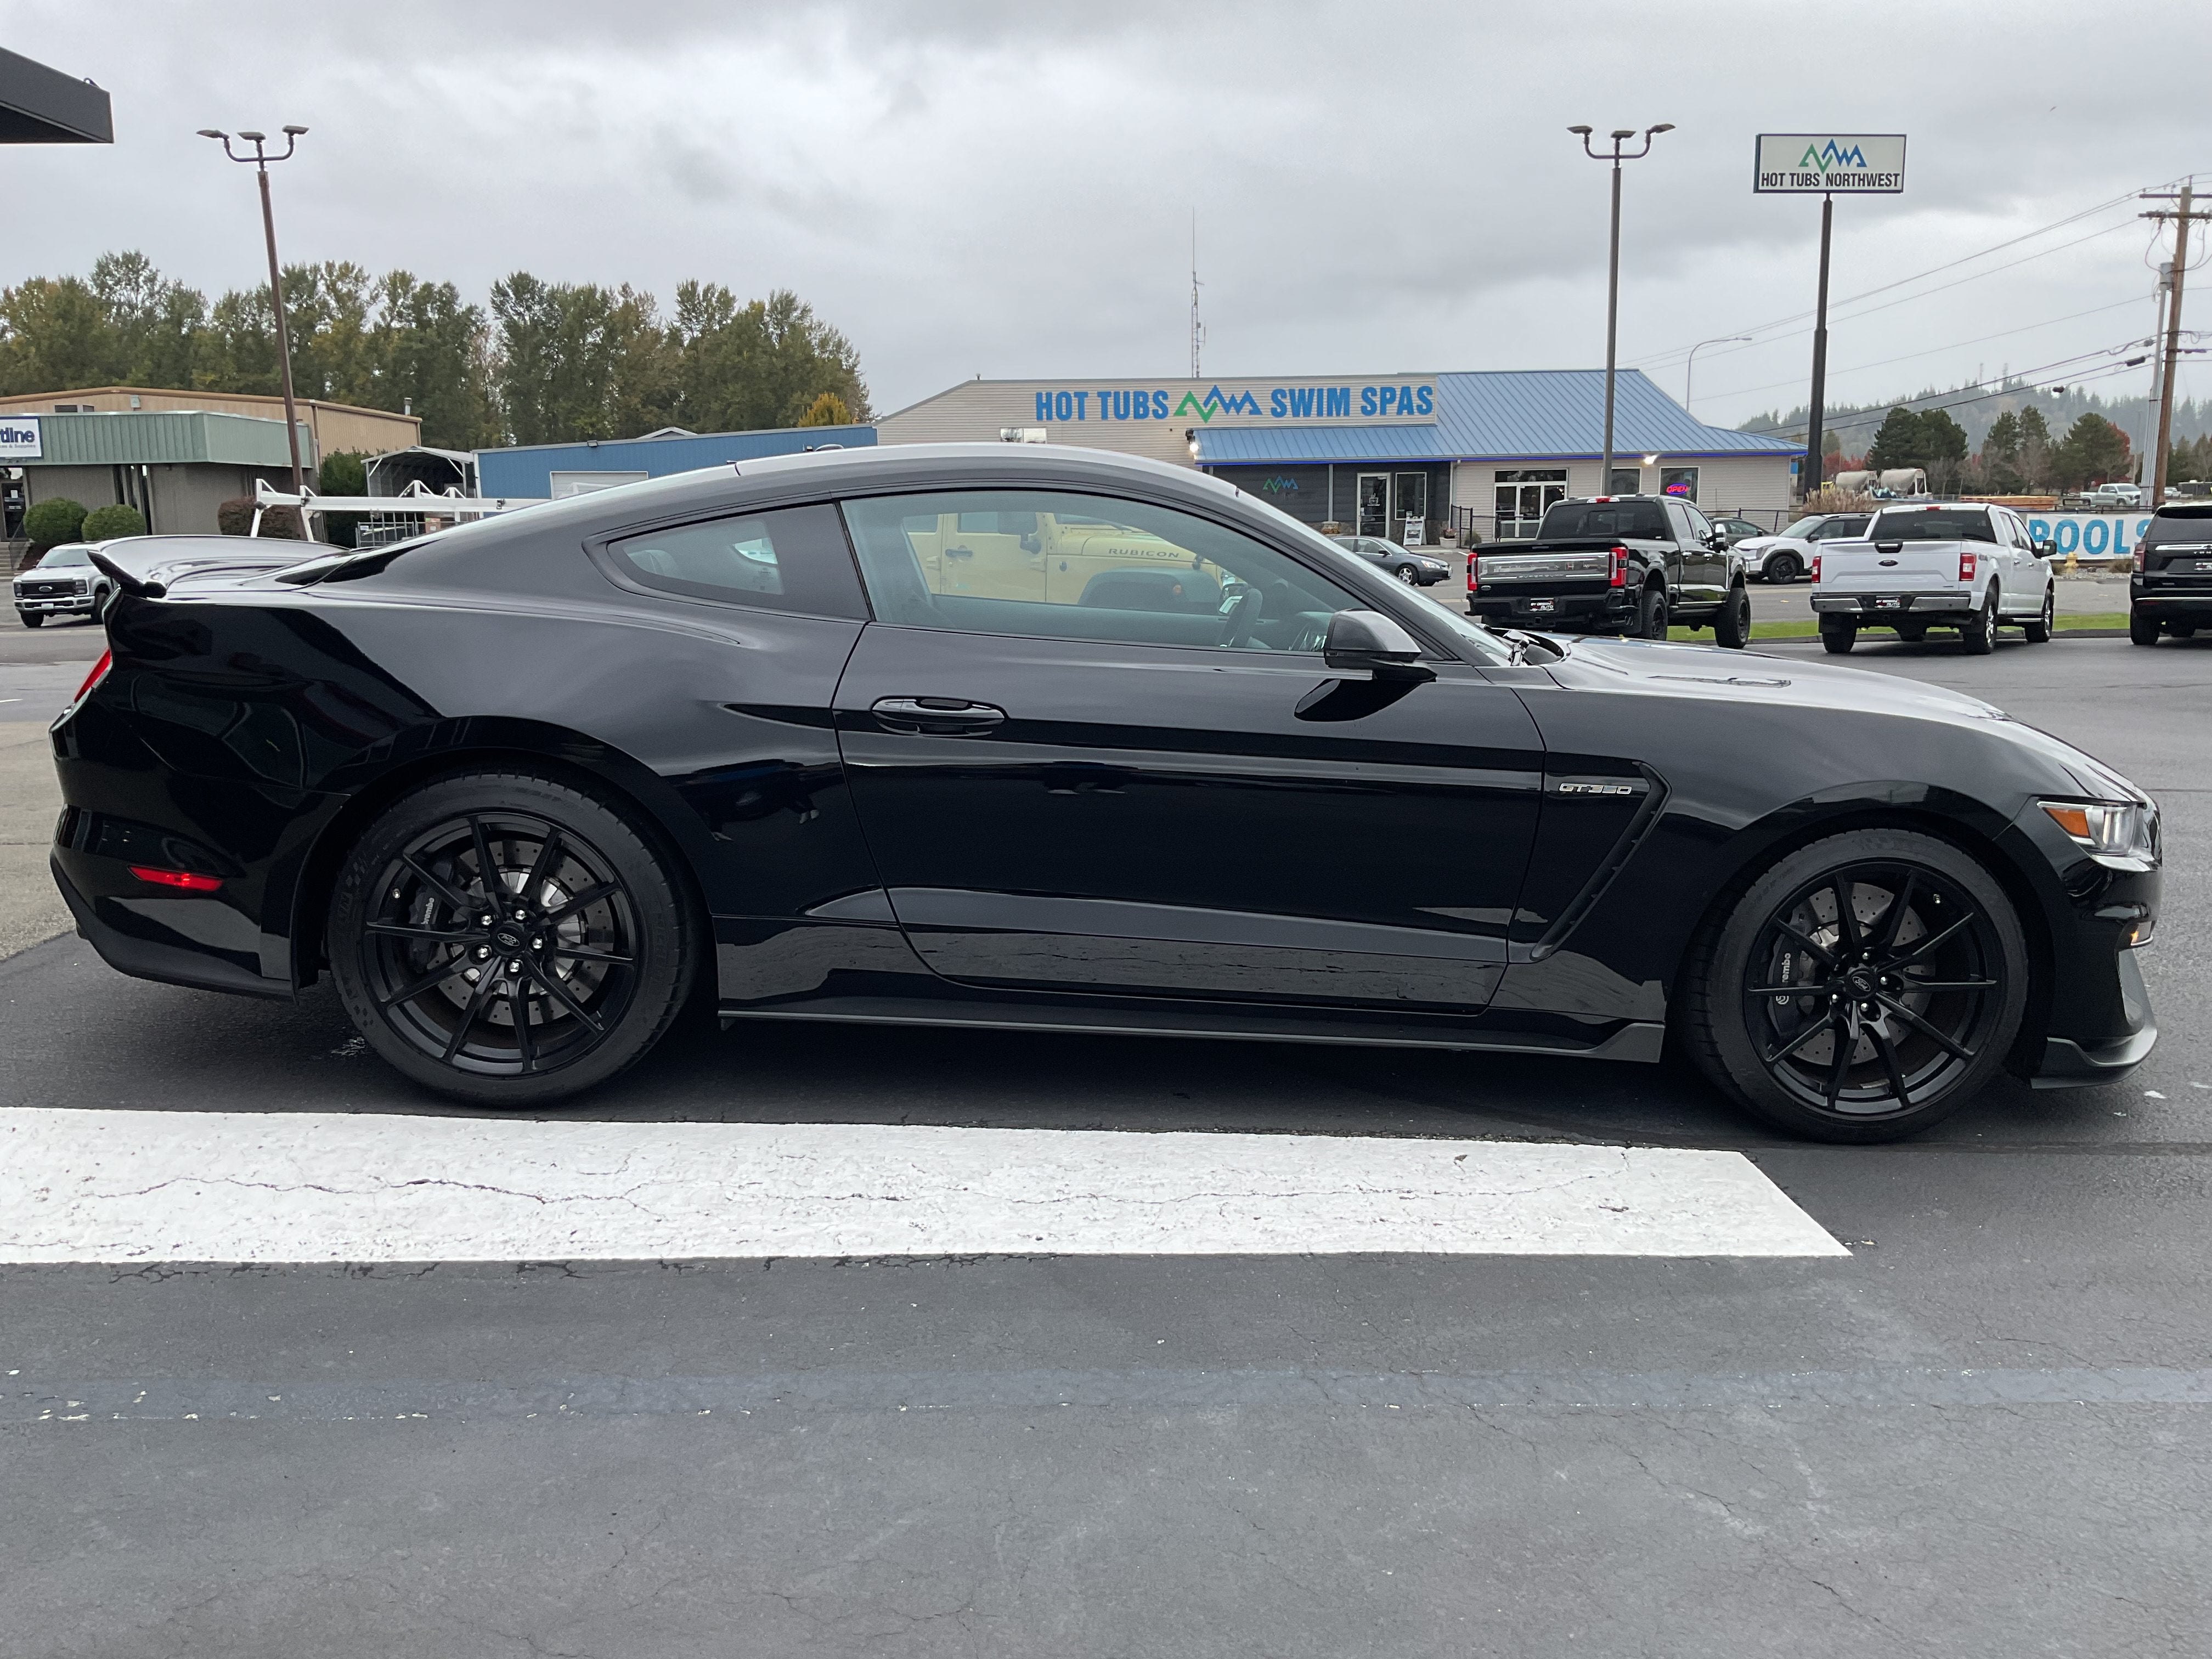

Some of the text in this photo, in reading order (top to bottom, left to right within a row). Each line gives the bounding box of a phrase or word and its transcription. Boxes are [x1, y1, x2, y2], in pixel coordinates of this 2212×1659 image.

[1761, 173, 1900, 187] HOT TUBS NORTHWEST
[1036, 390, 1169, 421] HOT TUBS
[1271, 386, 1433, 418] SWIM SPAS
[1109, 549, 1179, 557] RUBICON
[1559, 783, 1632, 794] GT350
